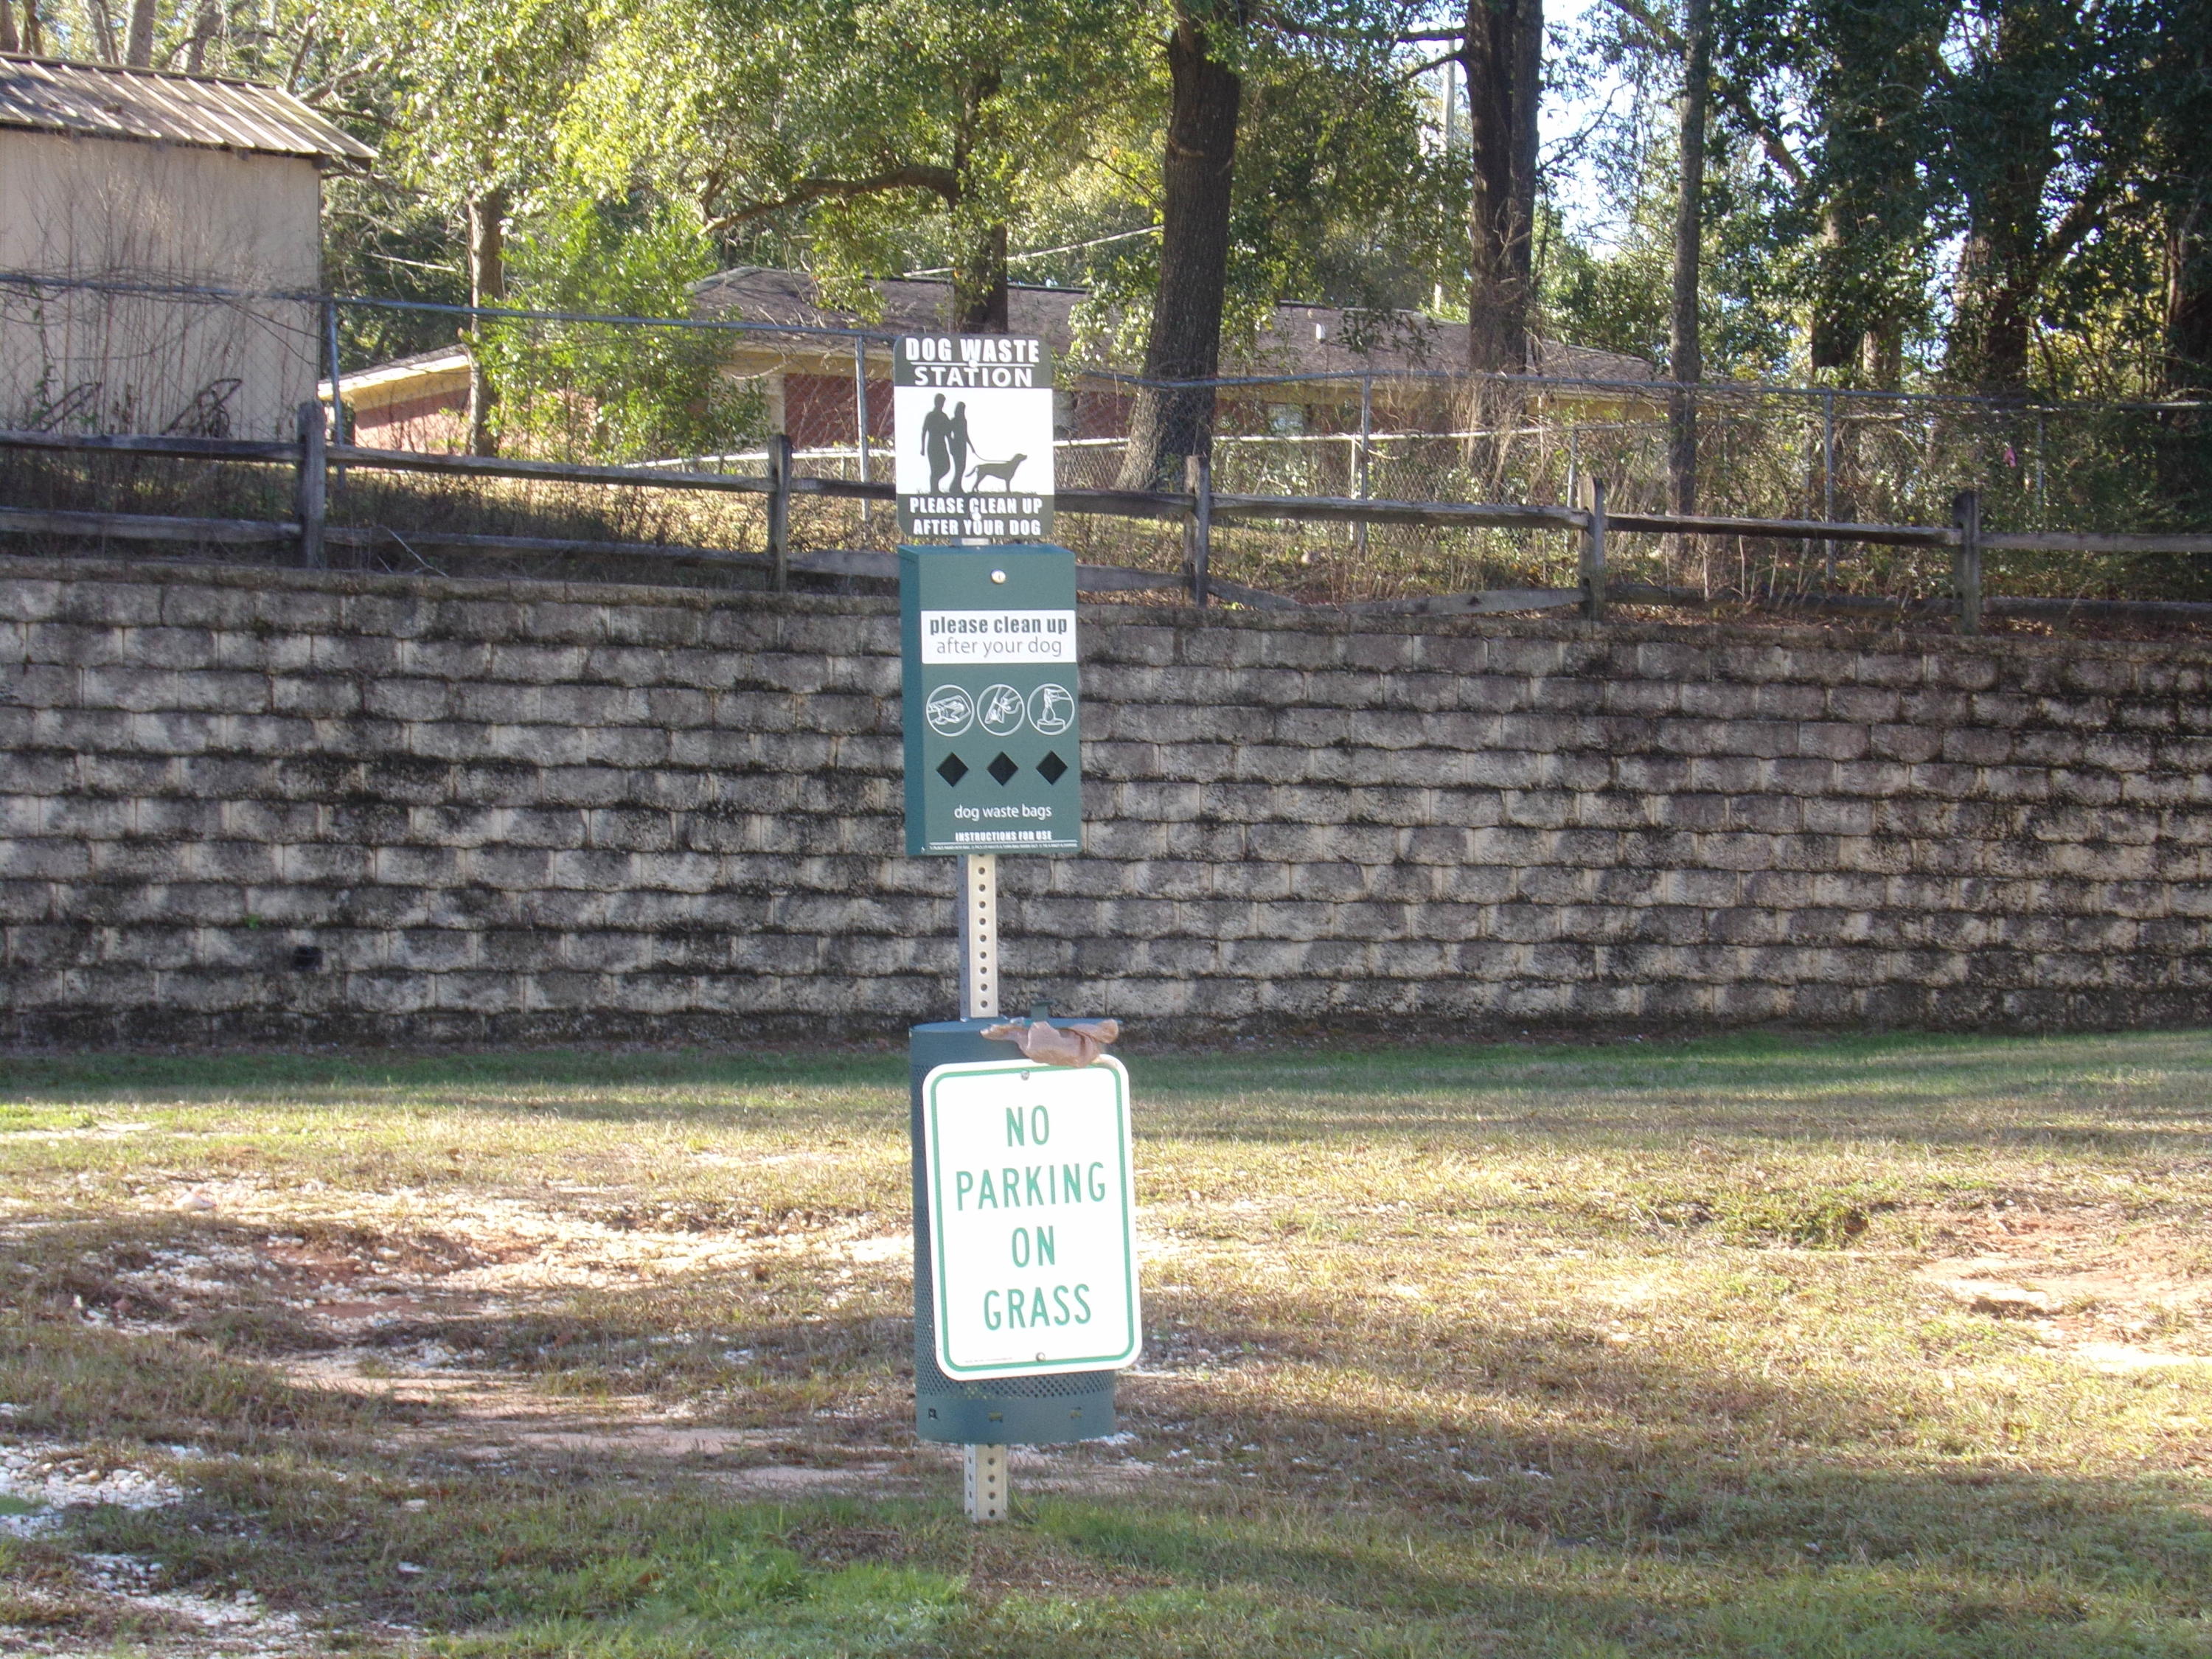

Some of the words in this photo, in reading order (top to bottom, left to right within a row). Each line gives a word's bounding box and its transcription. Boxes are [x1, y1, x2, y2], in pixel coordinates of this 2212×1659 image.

[905, 338, 952, 361] DOG
[960, 338, 1040, 363] WASTE
[914, 366, 1032, 387] STATION
[909, 497, 964, 514] PLEASE
[969, 497, 1018, 515] CLEAN
[1022, 498, 1043, 514] UP
[913, 519, 959, 536] AFTER
[963, 519, 1004, 536] YOUR
[1009, 519, 1041, 536] DOG
[929, 616, 988, 636] please
[993, 616, 1042, 634] clean
[1046, 618, 1068, 635] up
[936, 636, 978, 654] after
[982, 639, 1023, 658] your
[1028, 636, 1062, 658] dog
[954, 804, 980, 821] dog
[982, 805, 1020, 818] waste
[1021, 803, 1052, 821] bags
[955, 831, 1017, 842] INSTRUCTIONS
[1018, 830, 1035, 841] FOR
[1035, 830, 1053, 841] USE
[1005, 1105, 1050, 1147] NO
[956, 1161, 1106, 1211] PARKING
[1011, 1225, 1056, 1268] ON
[983, 1283, 1091, 1332] GRASS
